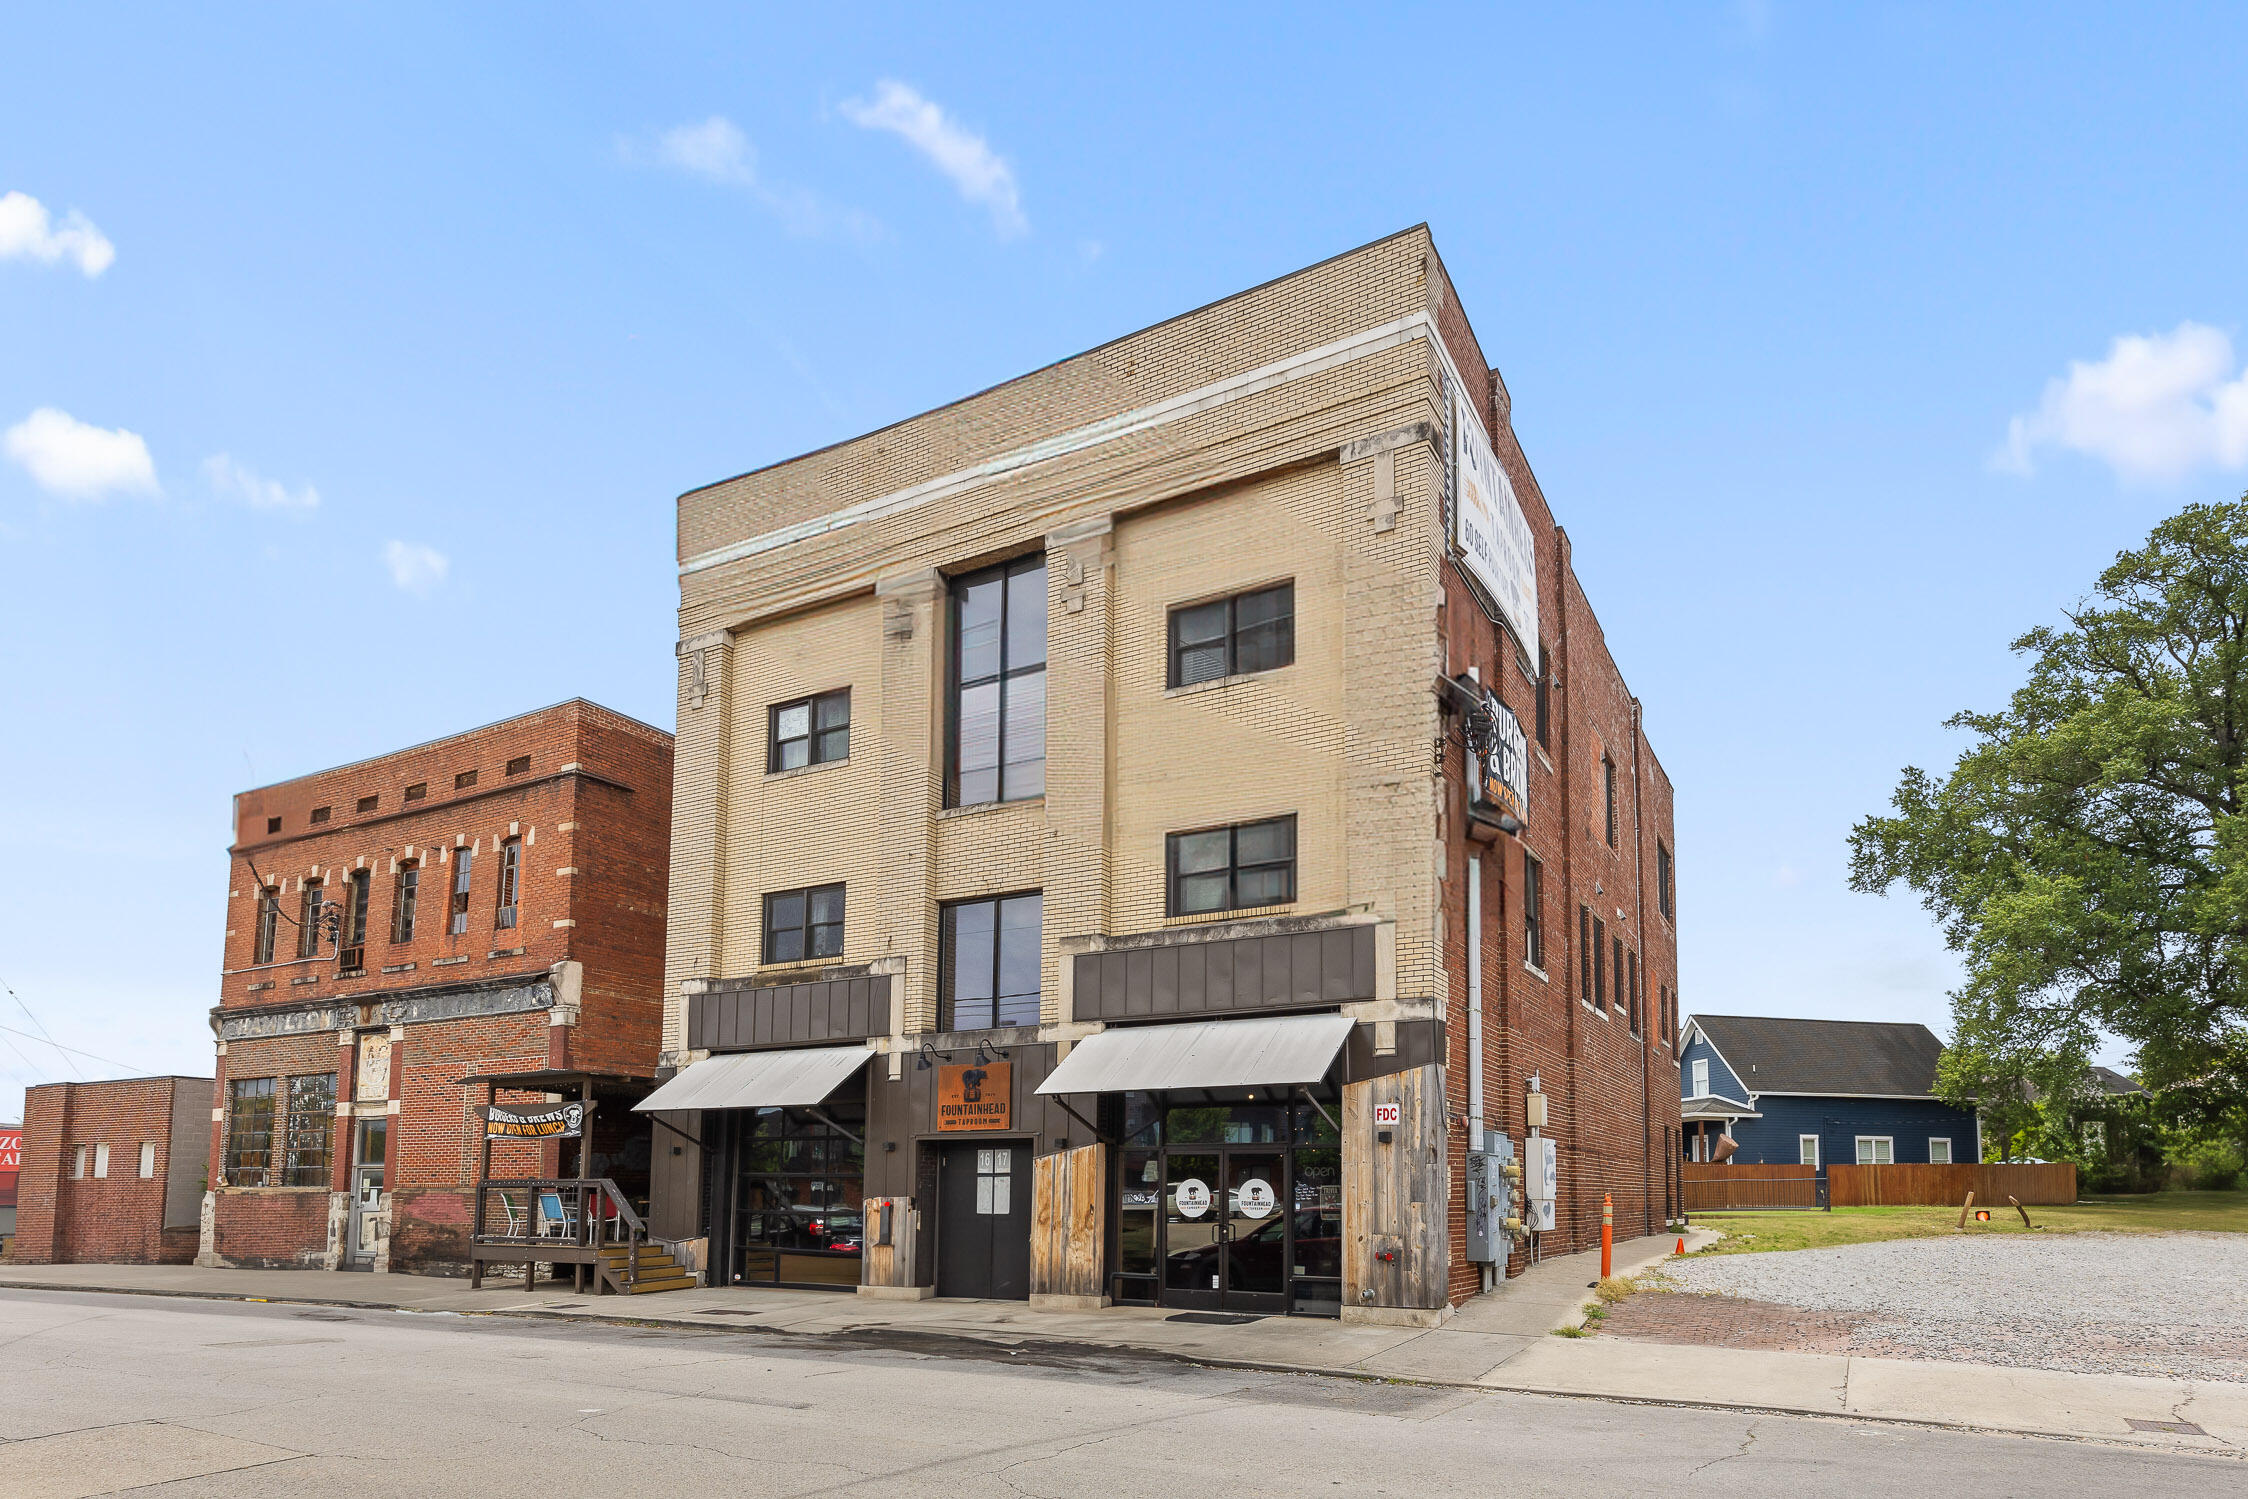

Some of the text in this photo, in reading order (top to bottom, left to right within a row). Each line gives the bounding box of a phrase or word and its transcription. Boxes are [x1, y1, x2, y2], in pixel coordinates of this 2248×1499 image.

[1475, 528, 1487, 563] SELF
[941, 1102, 1006, 1117] FOUNTAINHEAD
[1376, 1107, 1397, 1121] FDC
[487, 1121, 506, 1134] NOW
[521, 1124, 538, 1136] FOR
[537, 1121, 566, 1134] LUNCH
[958, 1117, 988, 1126] TAPROOM
[979, 1151, 1008, 1167] 16 17
[1304, 1166, 1336, 1179] open
